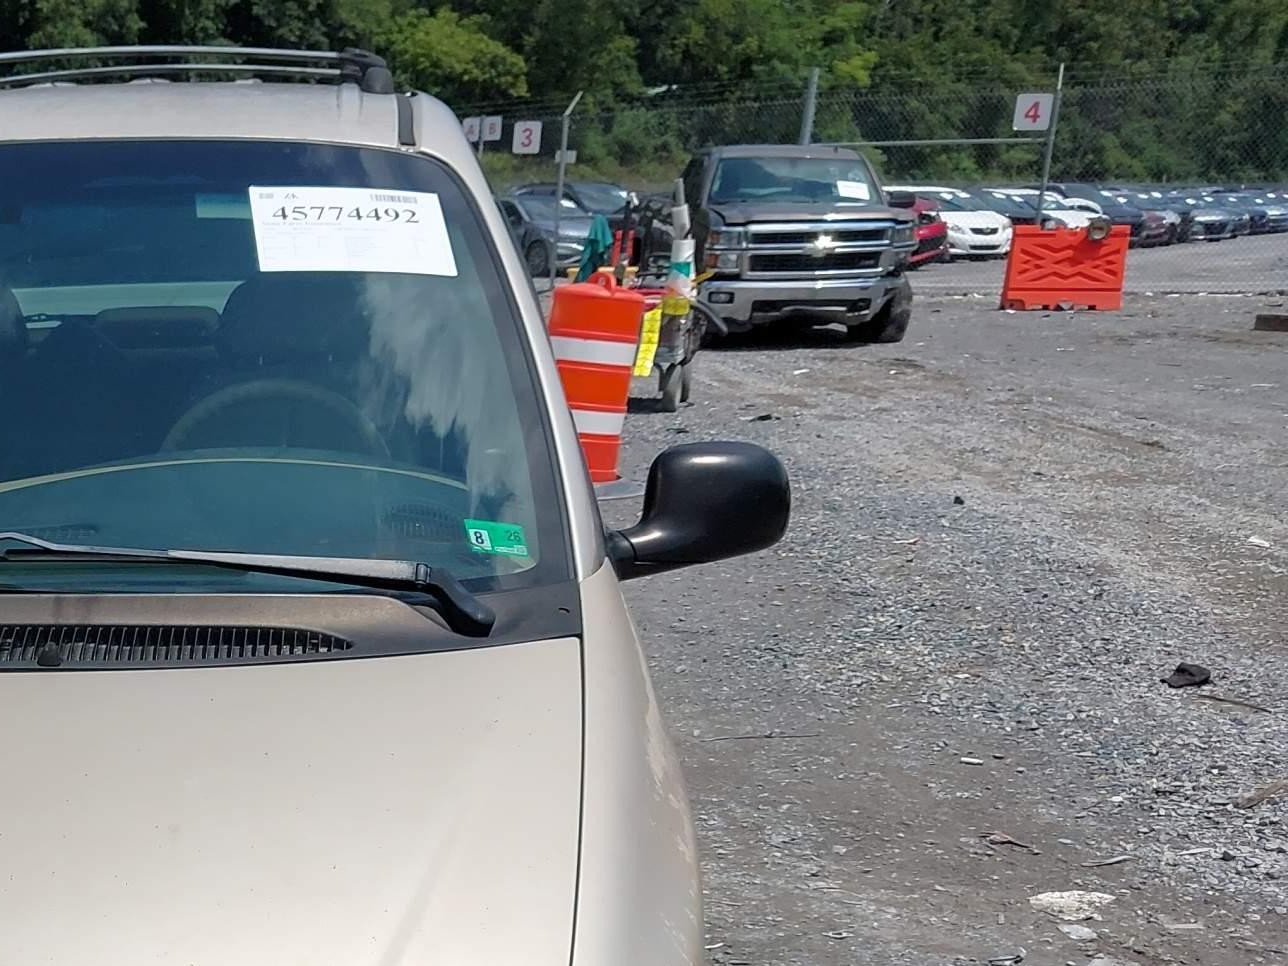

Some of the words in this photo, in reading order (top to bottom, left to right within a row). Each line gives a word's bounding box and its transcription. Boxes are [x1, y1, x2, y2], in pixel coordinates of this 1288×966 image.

[1024, 102, 1040, 123] 4
[521, 128, 533, 147] 3
[272, 206, 420, 223] 45774492
[474, 531, 485, 545] 8
